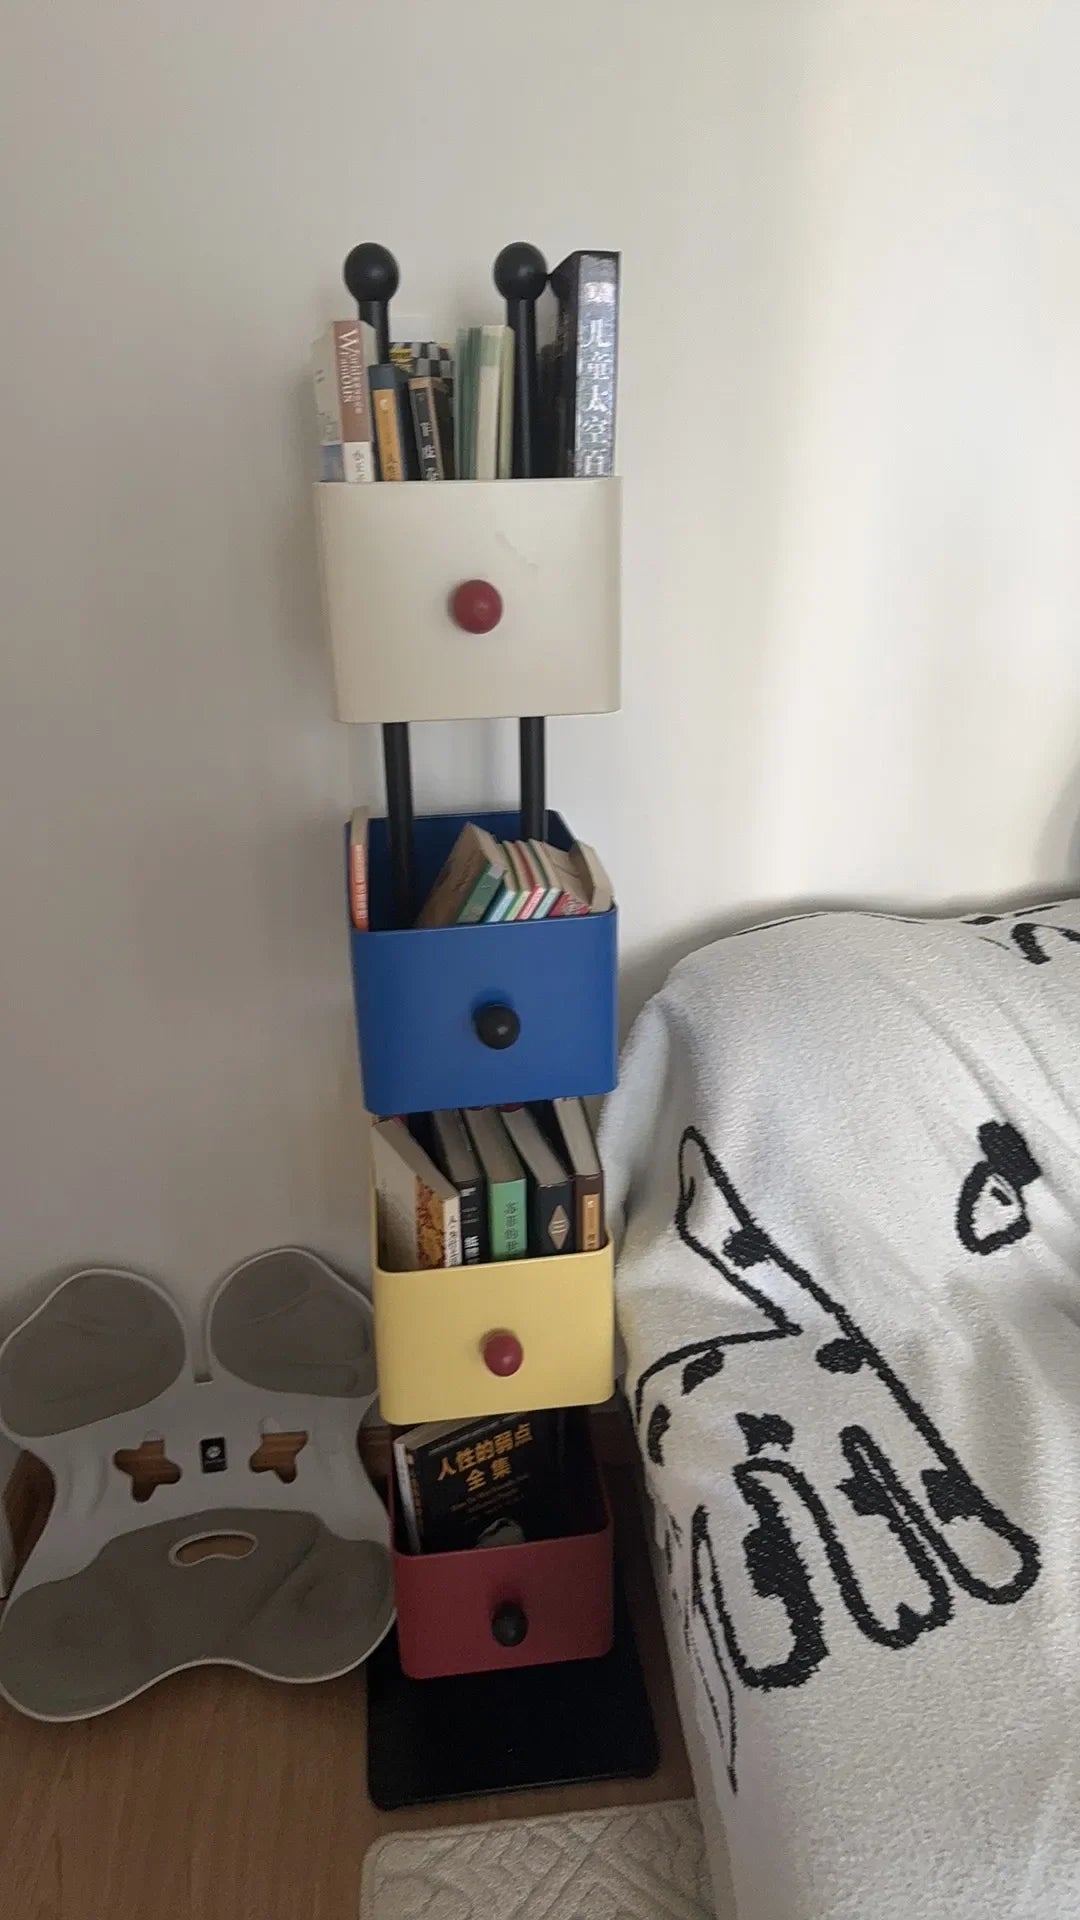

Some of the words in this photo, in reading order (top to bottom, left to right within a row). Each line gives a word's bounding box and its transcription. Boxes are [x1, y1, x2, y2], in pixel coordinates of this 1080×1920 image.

[580, 318, 614, 477] 儿童太空百
[437, 1422, 534, 1481] 人性的弱点
[465, 1456, 512, 1492] 全集
